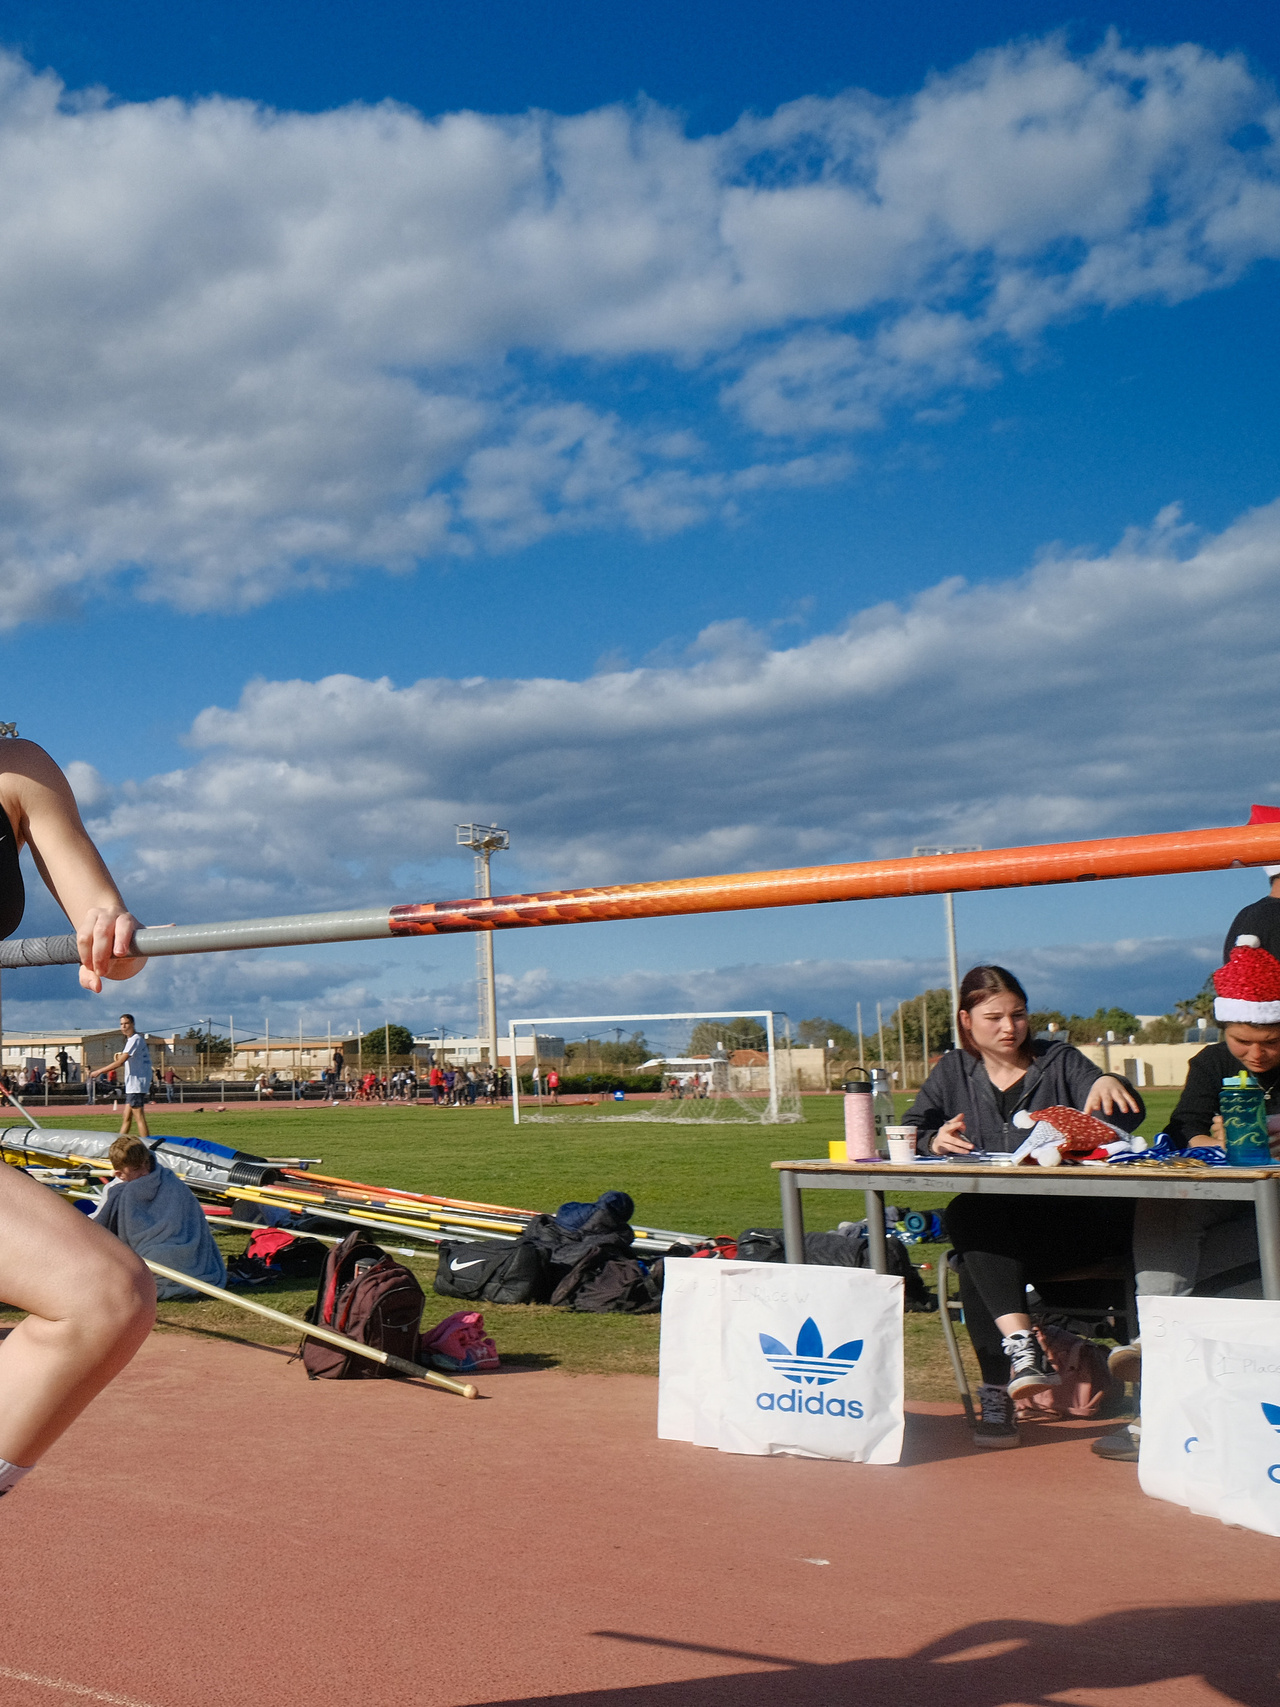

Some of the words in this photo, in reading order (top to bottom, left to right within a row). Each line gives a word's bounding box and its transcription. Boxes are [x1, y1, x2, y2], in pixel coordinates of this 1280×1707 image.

[1152, 1315, 1167, 1338] 3
[1183, 1338, 1200, 1363] 2
[1216, 1356, 1235, 1377] 1
[756, 1388, 864, 1419] adidas
